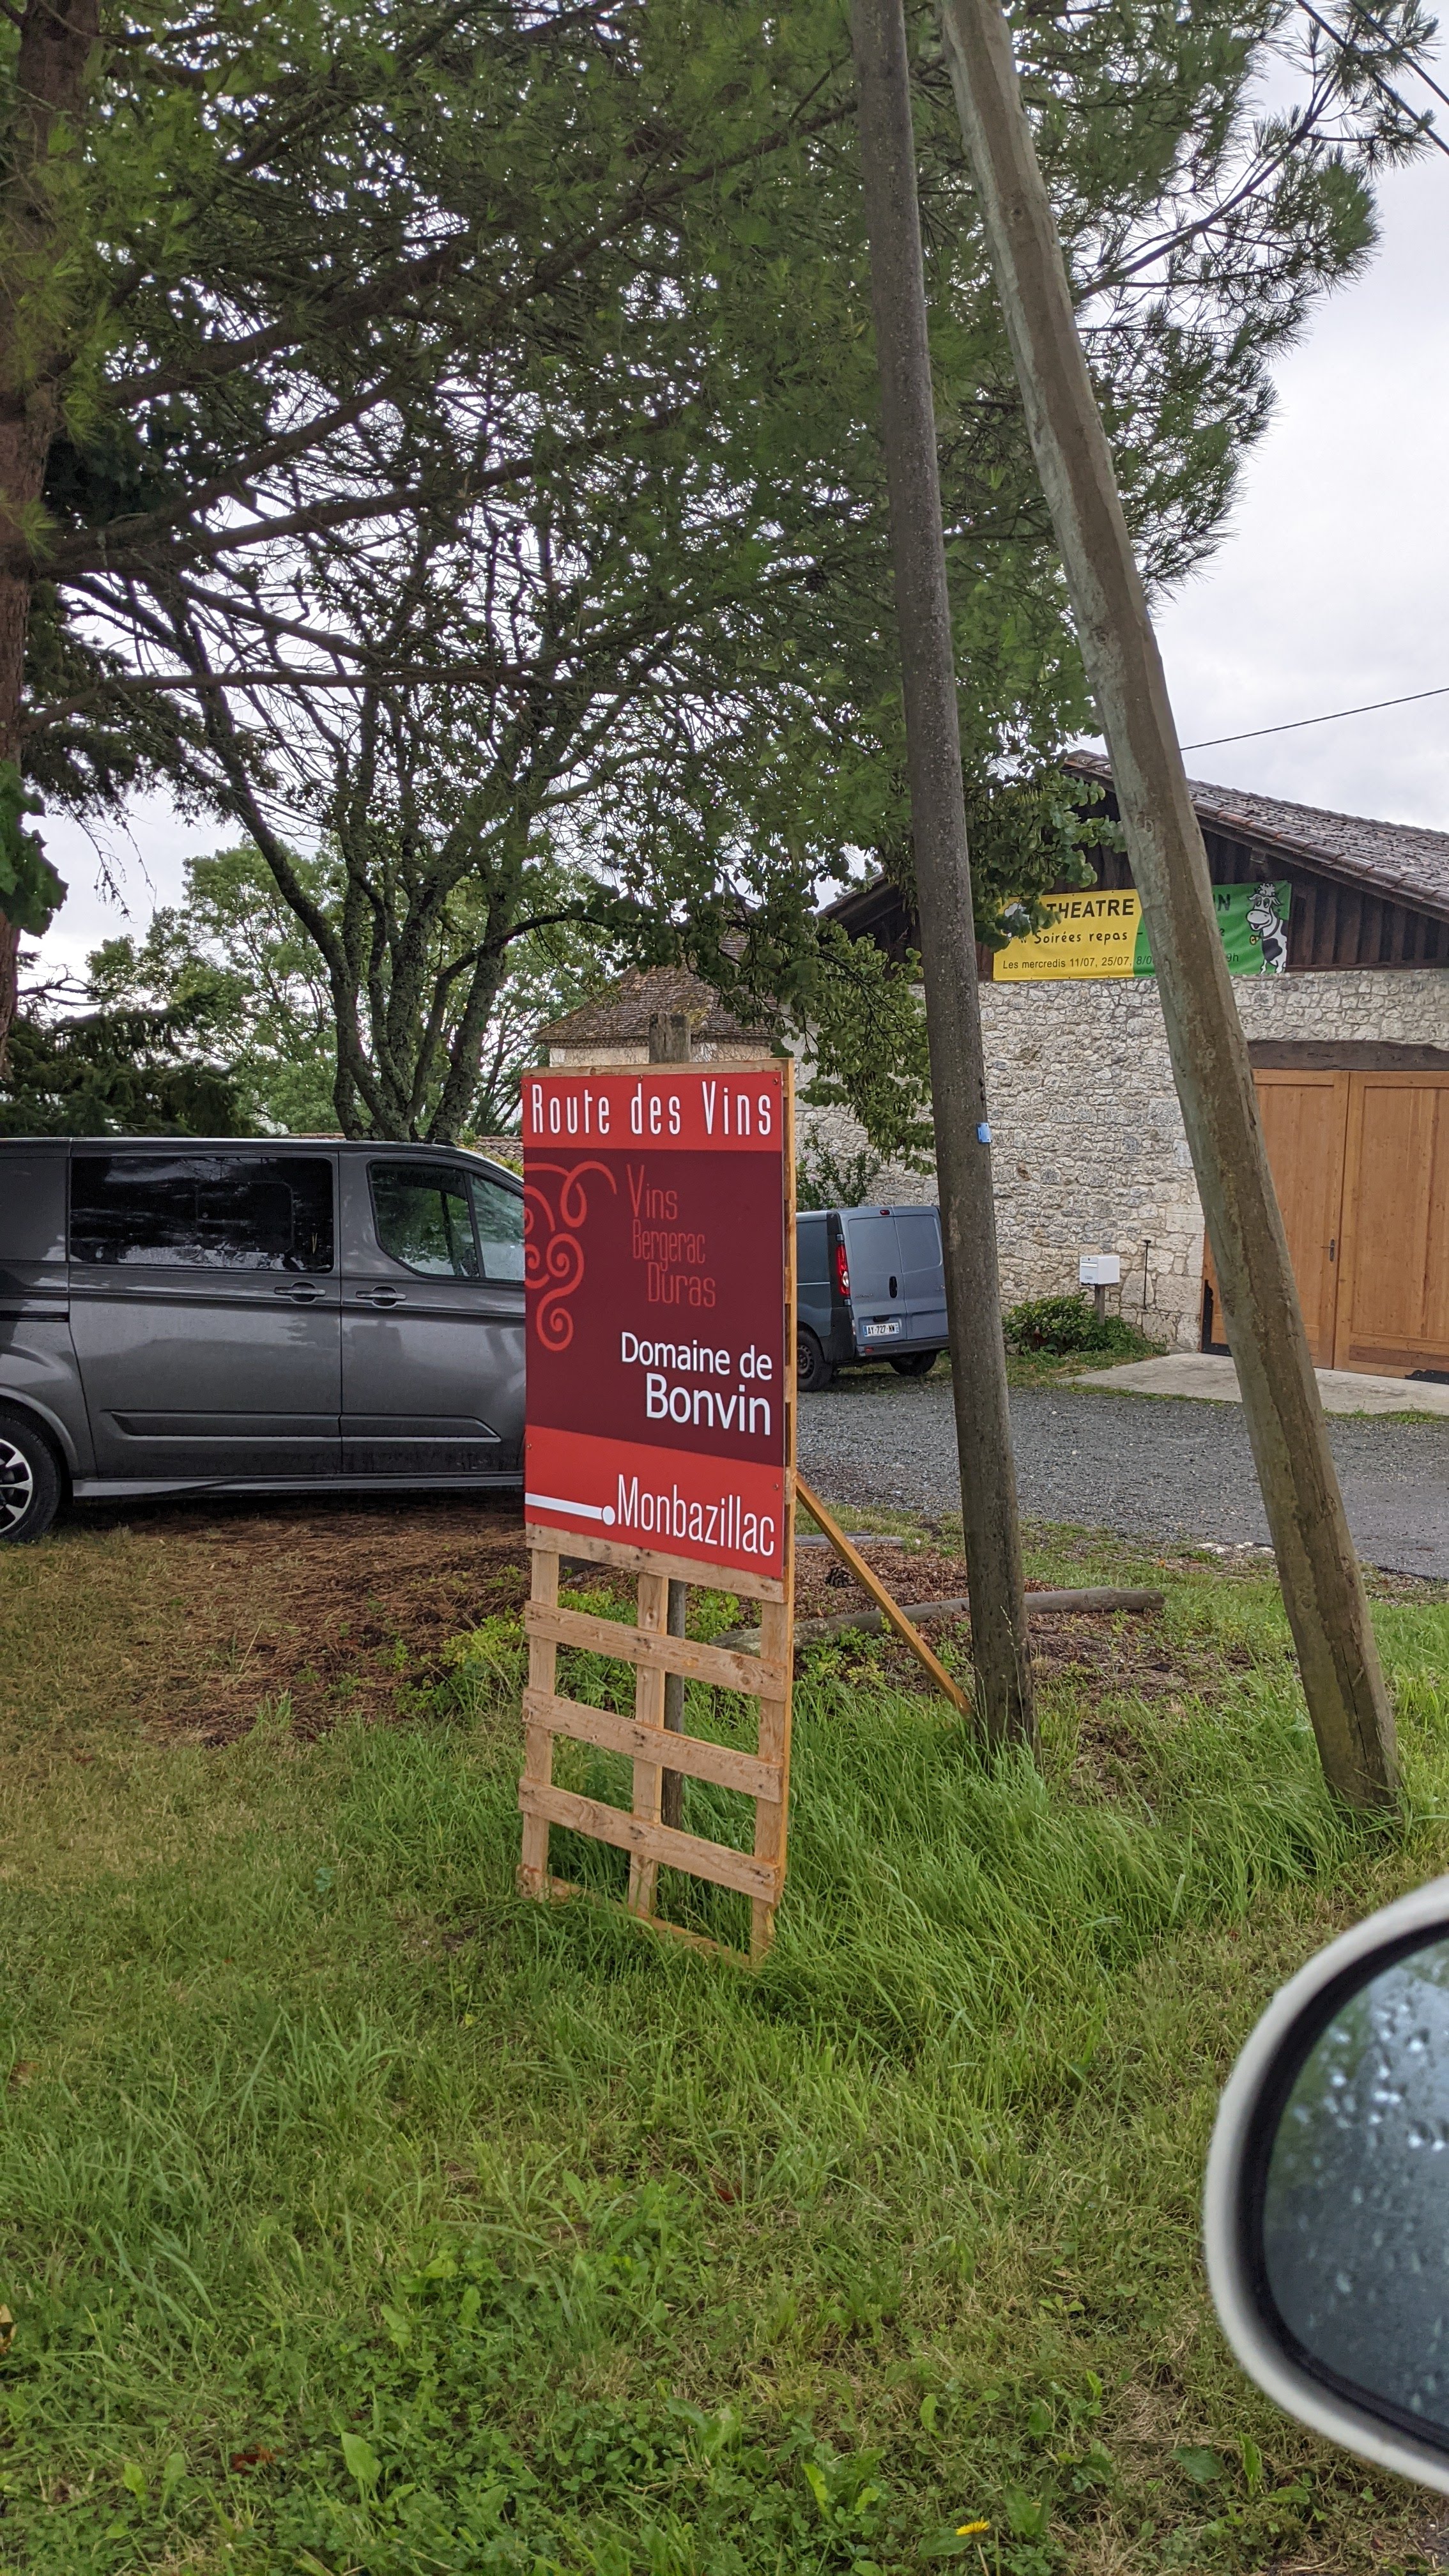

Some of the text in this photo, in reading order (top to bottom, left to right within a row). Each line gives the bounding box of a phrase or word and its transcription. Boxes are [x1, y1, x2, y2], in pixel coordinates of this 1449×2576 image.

[1002, 960, 1018, 969] Les
[1022, 958, 1066, 969] mercredis
[1070, 957, 1098, 968] 11/07,
[1101, 956, 1132, 967] 25/07,
[1136, 955, 1153, 965] 8/0
[1034, 930, 1082, 944] Soirées
[1089, 931, 1128, 946] repas
[532, 1080, 772, 1136] Route des Vins
[625, 1163, 678, 1220] Vins
[632, 1218, 706, 1271] Bergerac
[647, 1261, 716, 1308] Duras
[621, 1331, 773, 1381] Domaine de
[645, 1372, 771, 1436] Bonvin
[617, 1473, 774, 1556] Monbazillac
